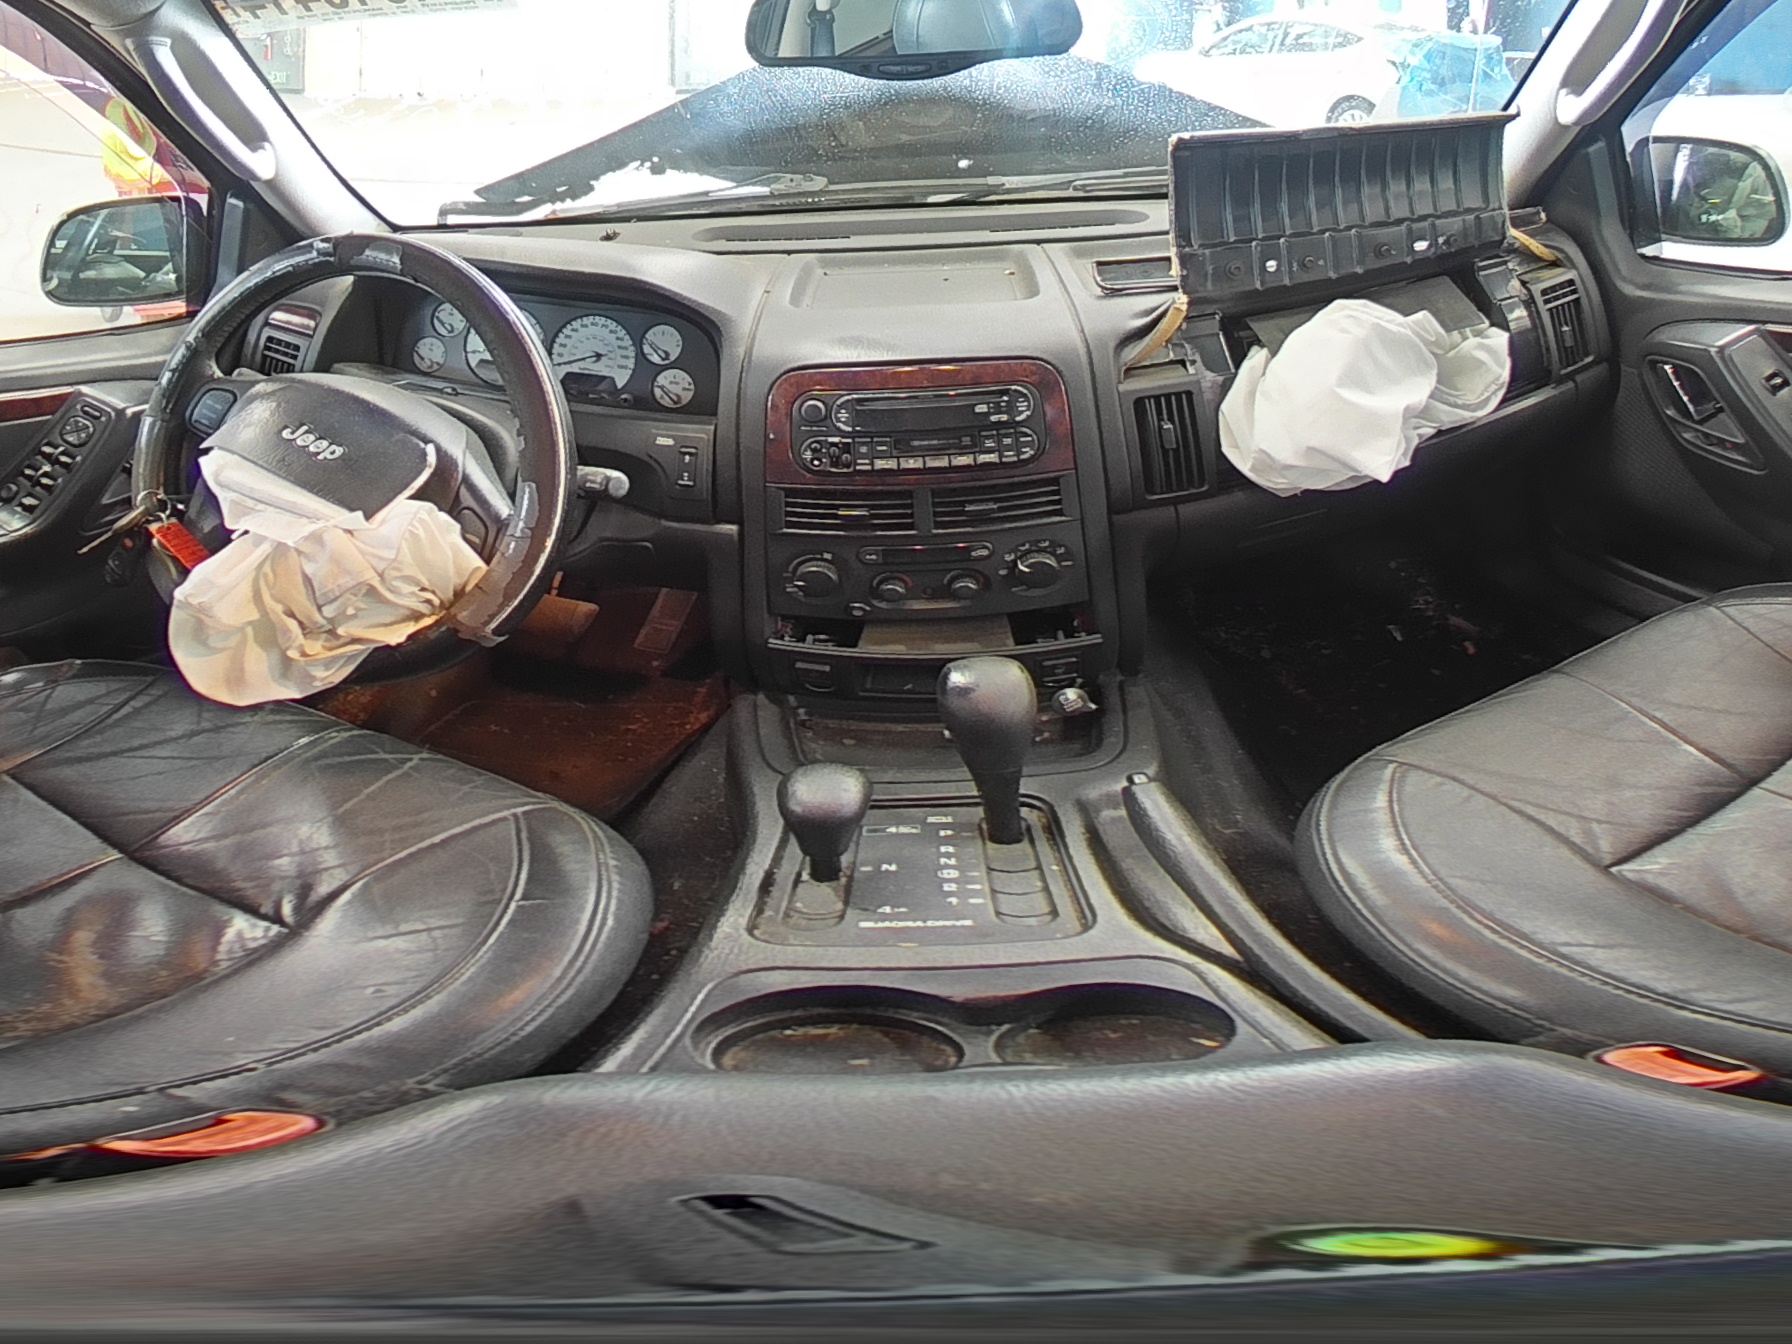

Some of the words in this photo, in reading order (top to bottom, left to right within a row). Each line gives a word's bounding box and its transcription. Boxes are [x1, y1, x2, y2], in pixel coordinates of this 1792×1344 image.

[281, 425, 344, 460] Jeep
[940, 845, 955, 853] R
[940, 857, 957, 865] N
[880, 863, 897, 871] N
